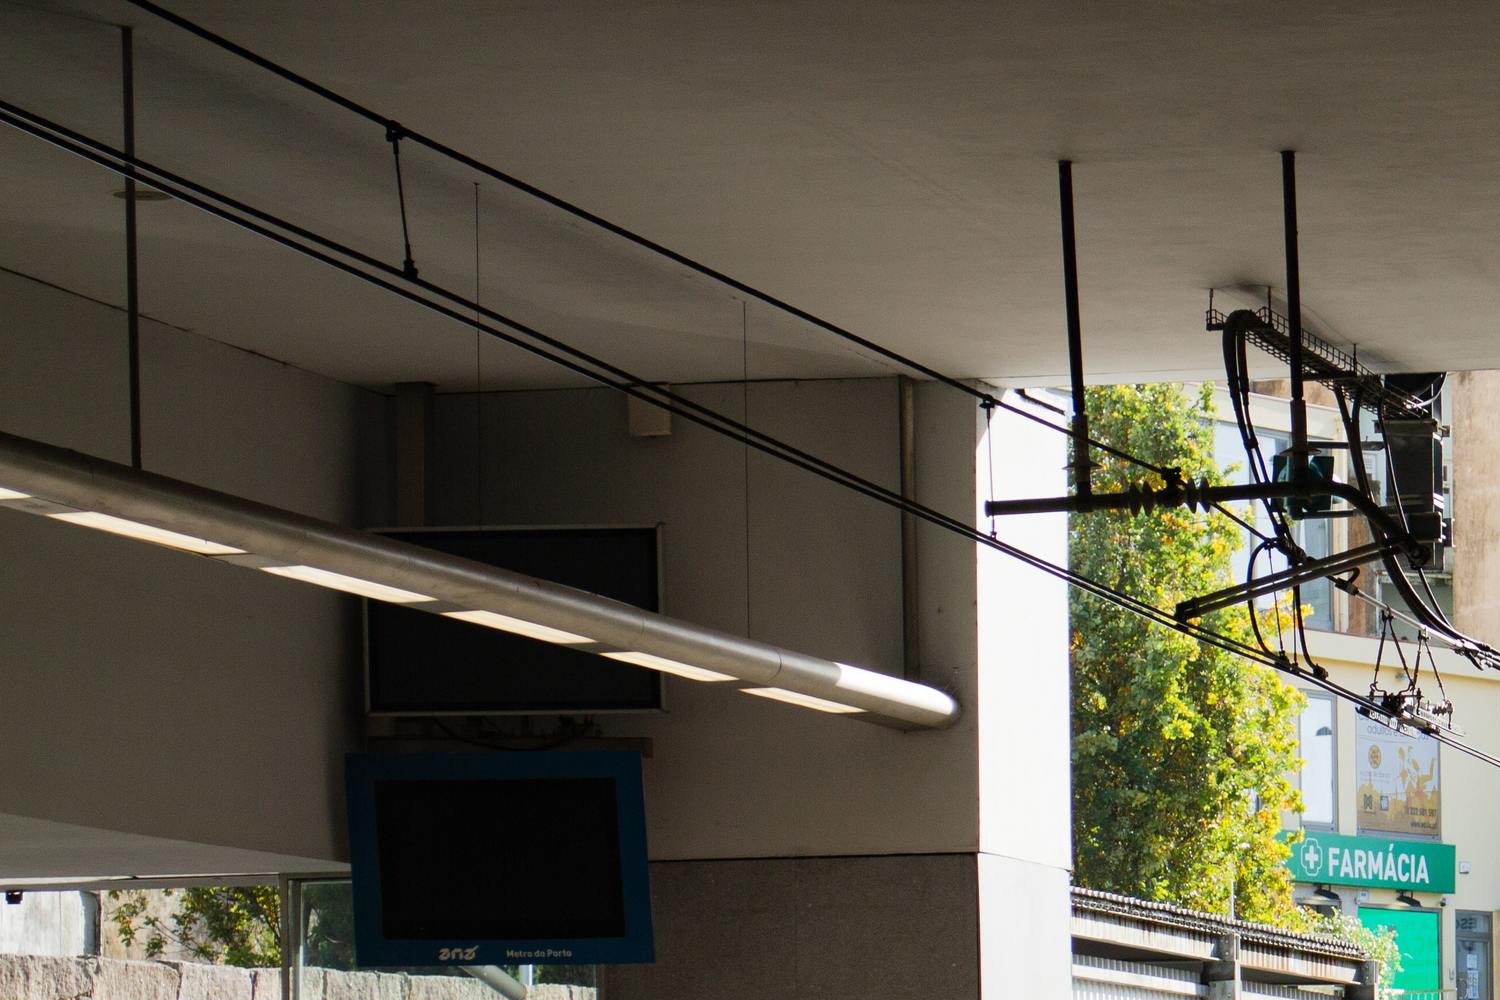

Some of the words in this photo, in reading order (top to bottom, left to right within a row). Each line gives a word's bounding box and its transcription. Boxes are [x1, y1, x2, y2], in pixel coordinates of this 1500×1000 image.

[1327, 843, 1430, 884] FARMÁCIA
[506, 949, 533, 958] Metro
[534, 950, 546, 958] do
[546, 949, 573, 958] Porto
